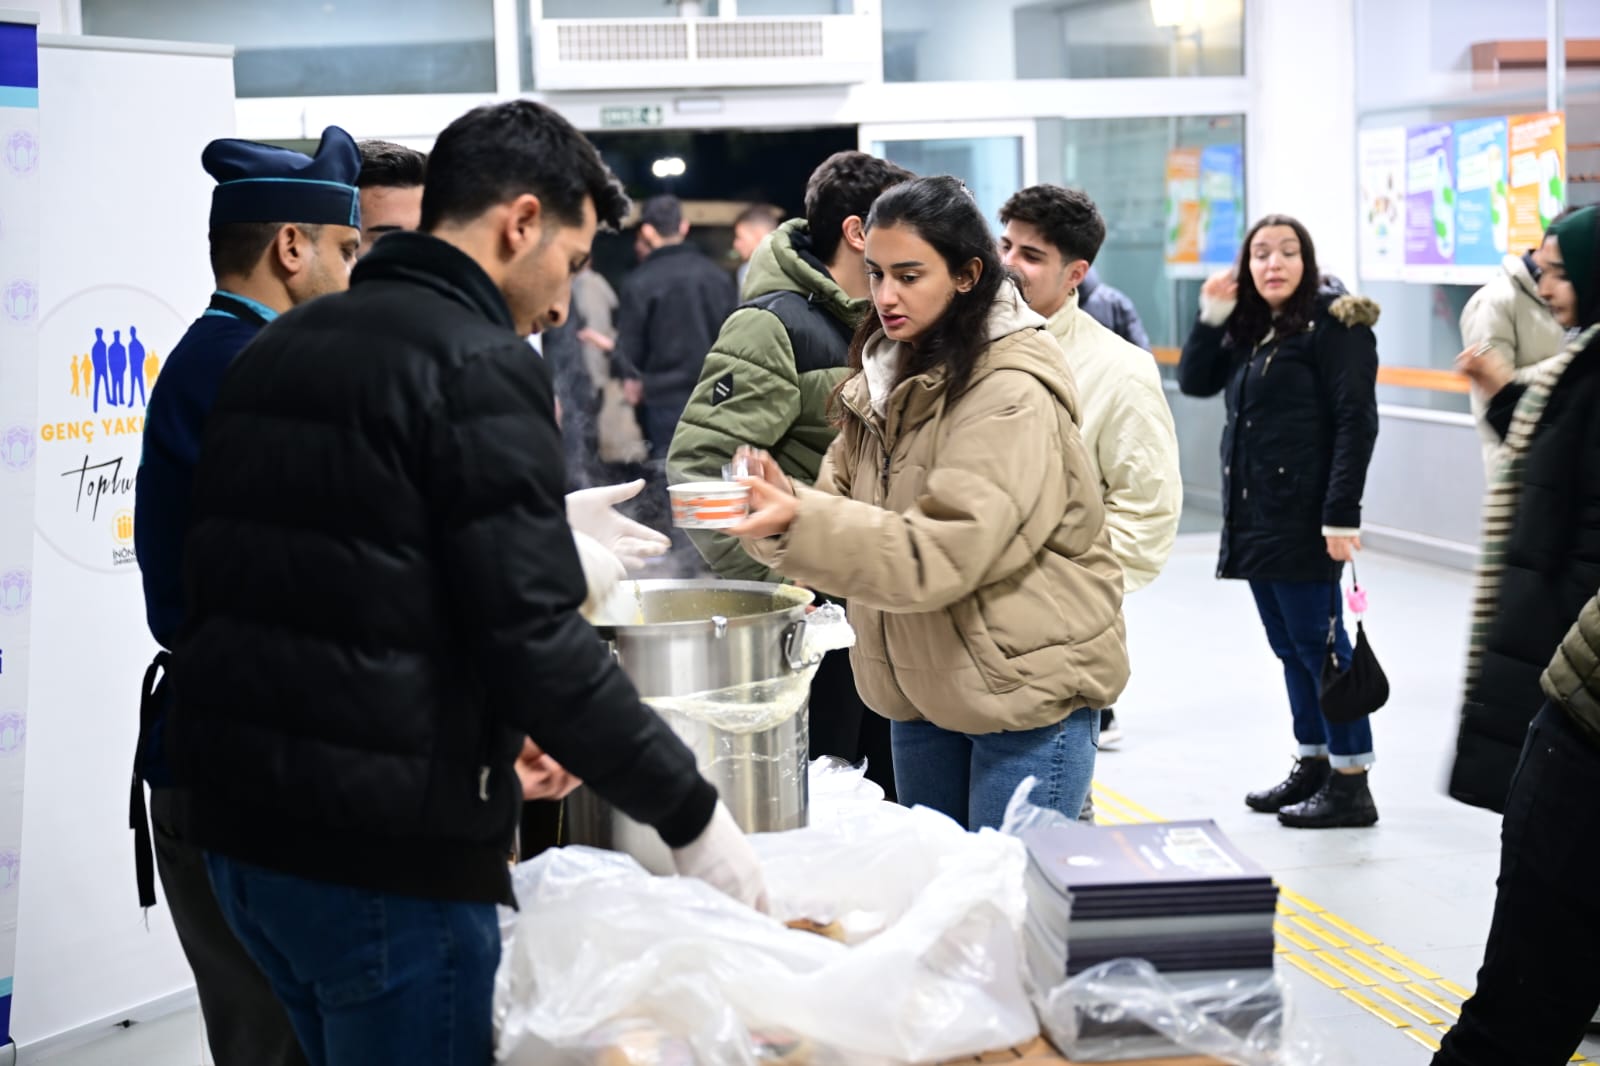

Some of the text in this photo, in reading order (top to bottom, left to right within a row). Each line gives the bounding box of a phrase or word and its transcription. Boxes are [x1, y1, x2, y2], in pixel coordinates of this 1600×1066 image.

[41, 416, 145, 443] GENÇ YAKI
[60, 454, 134, 522] Toplu
[112, 547, 137, 559] İNÖN
